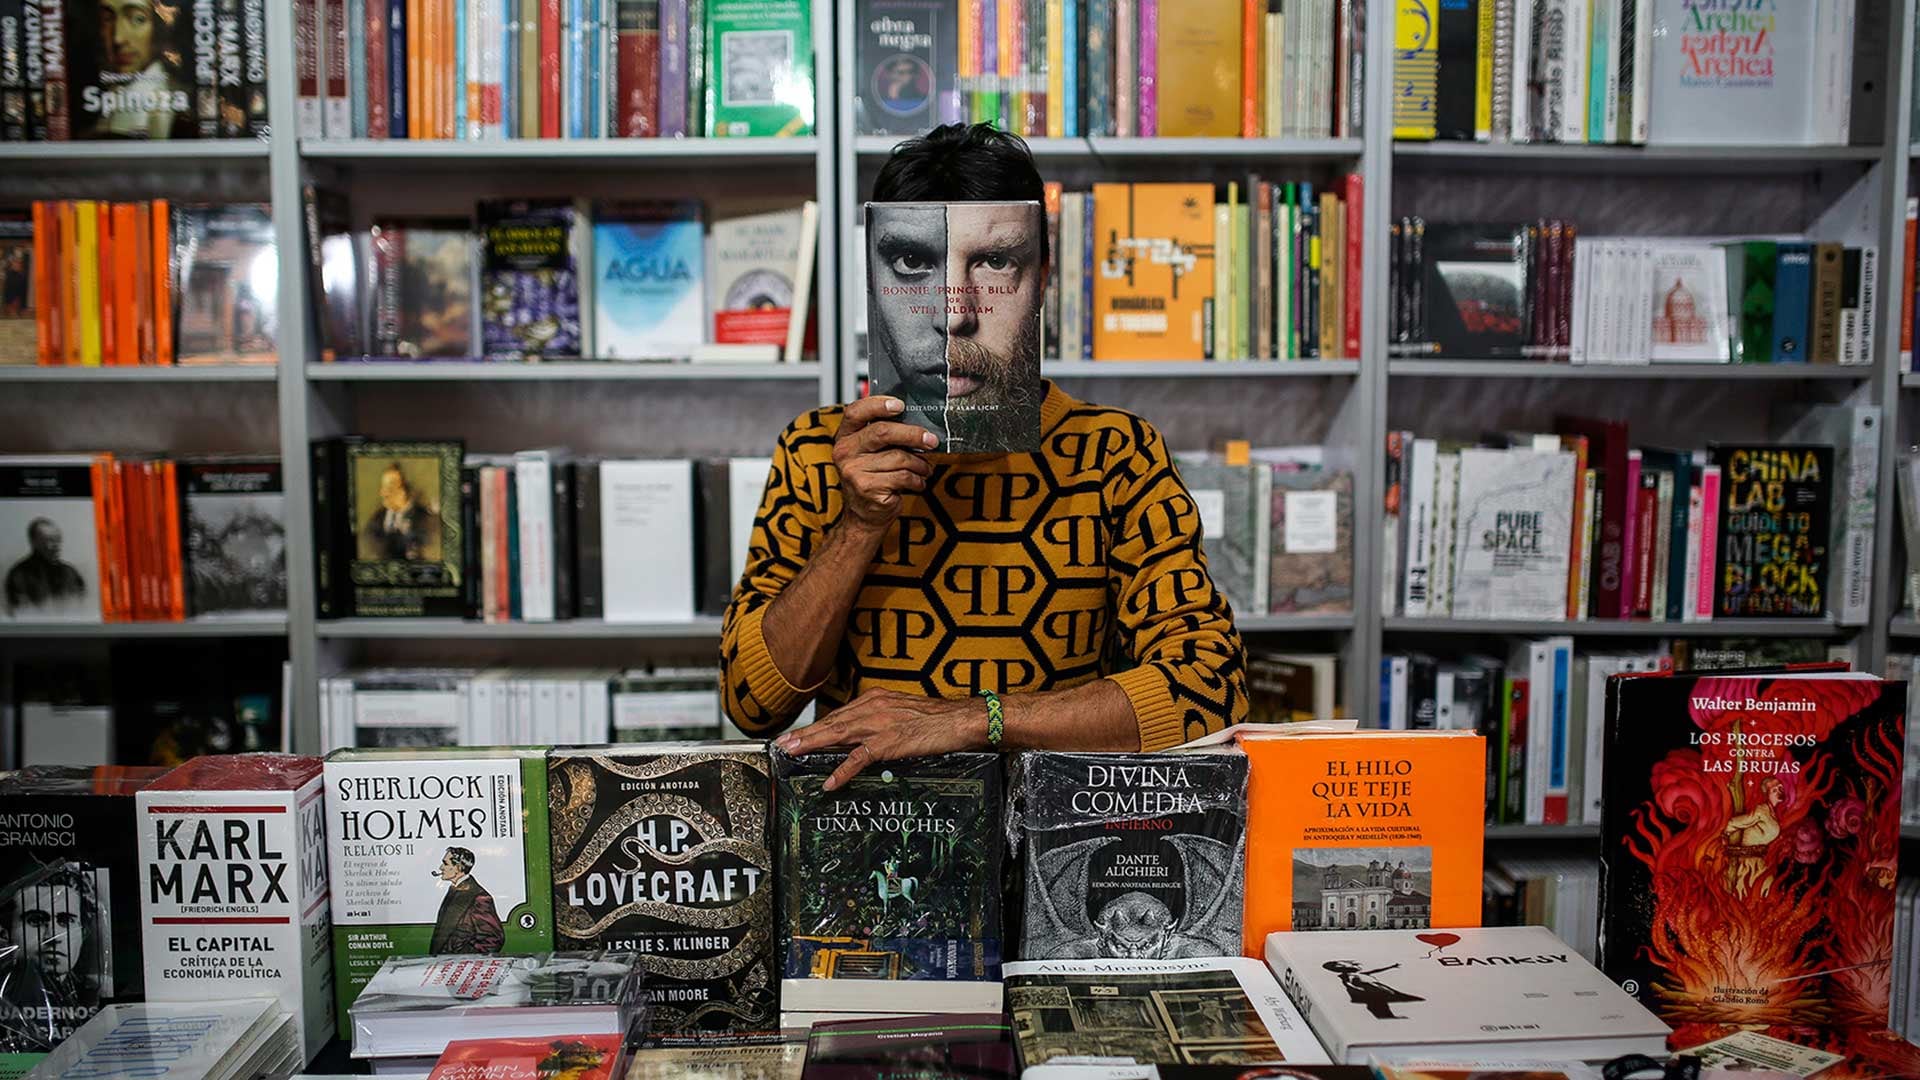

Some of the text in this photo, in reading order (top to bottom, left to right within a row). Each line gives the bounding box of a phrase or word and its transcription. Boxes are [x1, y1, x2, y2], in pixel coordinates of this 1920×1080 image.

[1680, 48, 1775, 76] Archea
[83, 86, 189, 118] Spinoza
[605, 257, 693, 281] AGUA
[882, 286, 930, 295] BONNIE
[988, 286, 1019, 294] BILLY
[909, 306, 994, 315] WILL OLDHAM
[1729, 449, 1821, 482] CHINA
[1728, 481, 1785, 512] LAB
[1497, 511, 1544, 529] PURE
[1482, 529, 1542, 552] SPACE
[1695, 649, 1746, 663] Merging
[1692, 698, 1816, 714] Walter Benjamin
[1690, 733, 1817, 746] LOS PROCESOS
[1729, 749, 1775, 758] CONTRA
[1327, 760, 1412, 776] EL HILO
[1703, 760, 1801, 775] LAS BRUJAS
[1087, 766, 1191, 788] DIVINA
[338, 775, 484, 801] SHERLOCK
[620, 780, 700, 791] EDICIÓN ANOTADA
[1312, 781, 1411, 800] QUE TEJE
[496, 775, 507, 838] EDICIÓN ANOTADA
[835, 801, 938, 815] LAS MIL Y
[1071, 792, 1205, 814] COMEDIA
[1326, 802, 1412, 818] LA VIDA
[0, 813, 74, 829] ANTONIO
[341, 808, 486, 841] HOLMES
[816, 817, 956, 833] UNA NOCHES
[1105, 819, 1173, 830] INFIERNO
[0, 831, 76, 846] GRAMSCI
[156, 819, 283, 860] KARL
[637, 820, 689, 853] H.P.
[344, 844, 414, 856] RELATOS II
[1116, 855, 1160, 865] DANTE
[344, 869, 374, 877] Sherlock
[1105, 866, 1169, 877] ALIGHIERI
[151, 863, 290, 904] MARX
[568, 868, 760, 907] LOVECRAFT
[1092, 881, 1119, 889] EDICIÓN
[1151, 881, 1181, 889] BILINGÜE
[356, 889, 381, 897] archivo
[181, 905, 259, 914] [FRIEDRICH ENGELS]
[346, 898, 374, 906] Sherlock
[169, 937, 275, 952] EL CAPITAL
[348, 942, 372, 950] CONAN
[607, 936, 730, 952] LESLIE S. KLINGER
[180, 955, 263, 968] CRÍTICA DE LA
[1039, 961, 1212, 973] Atlas Mnemosyne
[1438, 954, 1570, 967] BANKSY
[163, 967, 282, 979] ECONOMÍA POLÍTICA
[668, 988, 709, 1001] MOORE
[1713, 986, 1769, 995] Ilustración de
[1712, 996, 1769, 1004] Claudio Romo
[442, 1065, 519, 1074] CARMEN
